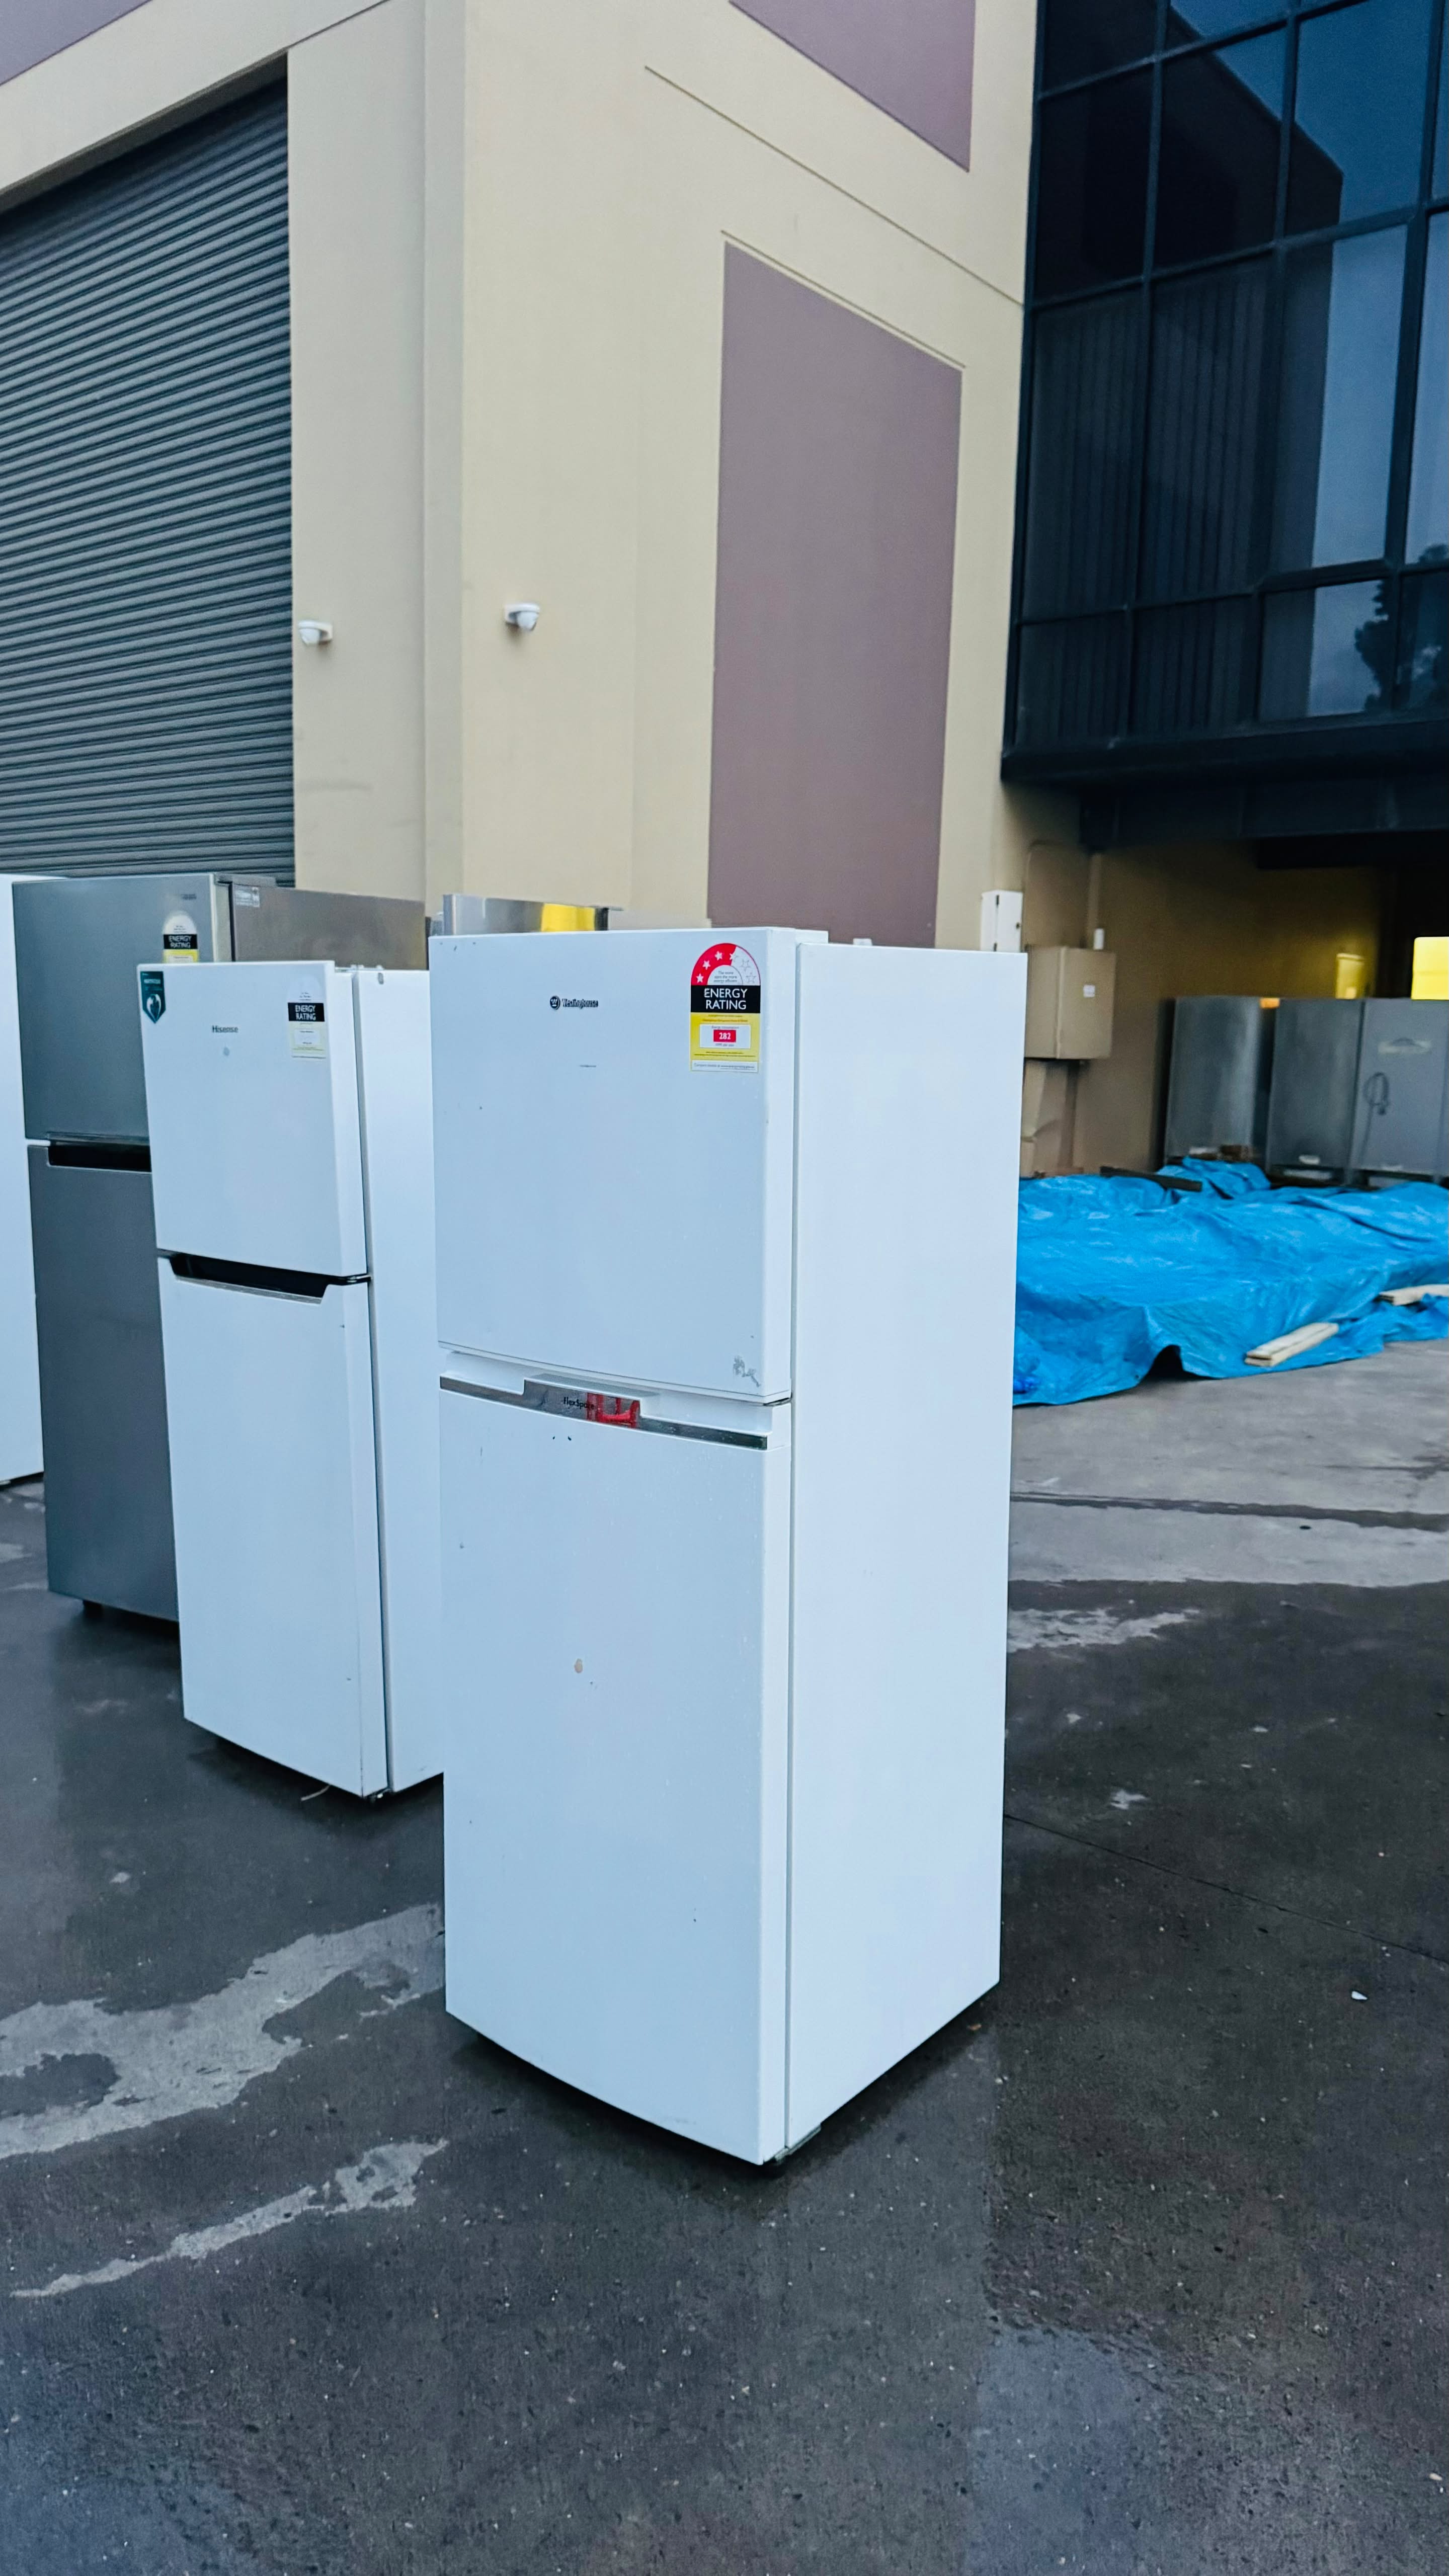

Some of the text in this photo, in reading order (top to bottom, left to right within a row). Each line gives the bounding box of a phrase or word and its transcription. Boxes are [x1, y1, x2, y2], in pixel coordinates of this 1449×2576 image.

[704, 988, 748, 999] ENERGY
[562, 998, 598, 1009] Westinghouse
[706, 999, 747, 1010] RATING
[212, 1025, 238, 1033] Hisense
[719, 1032, 731, 1040] 282
